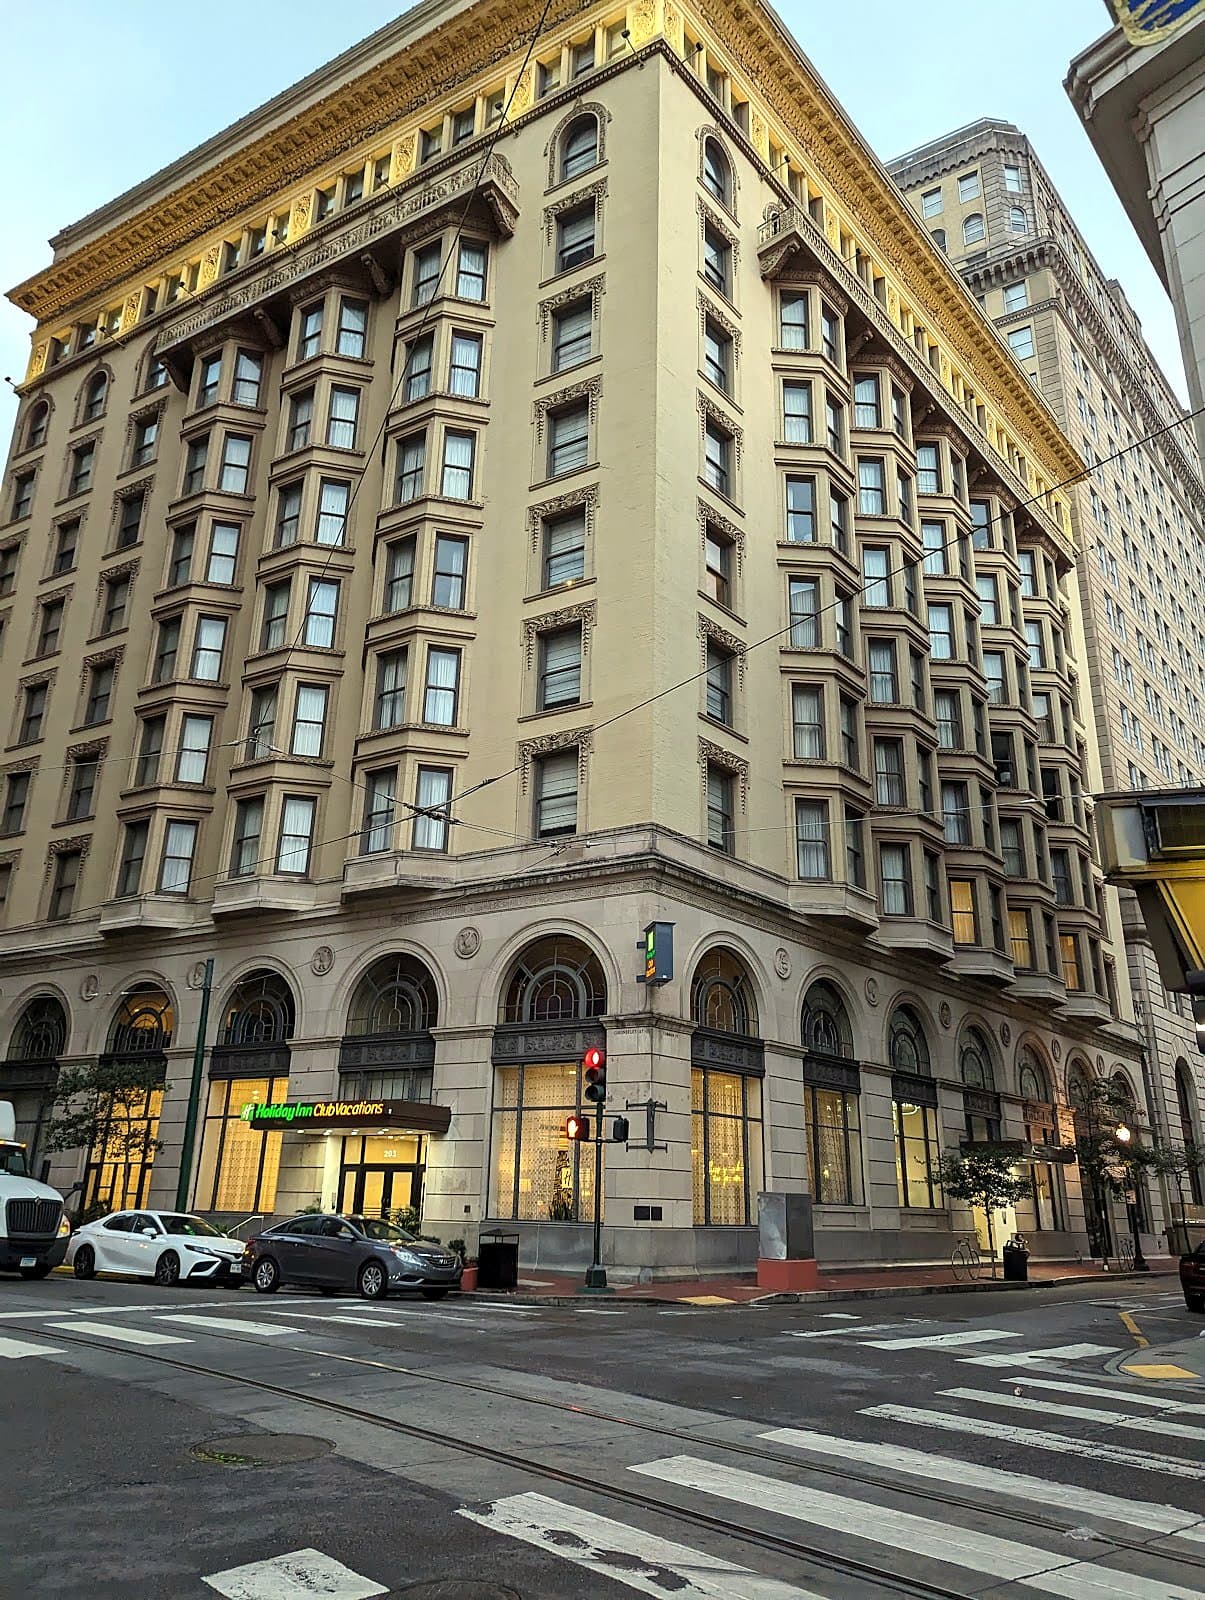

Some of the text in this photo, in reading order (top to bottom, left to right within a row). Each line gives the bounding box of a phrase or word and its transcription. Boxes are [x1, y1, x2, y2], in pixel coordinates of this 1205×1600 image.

[255, 1101, 384, 1121] Holiday Inn Club Vacations
